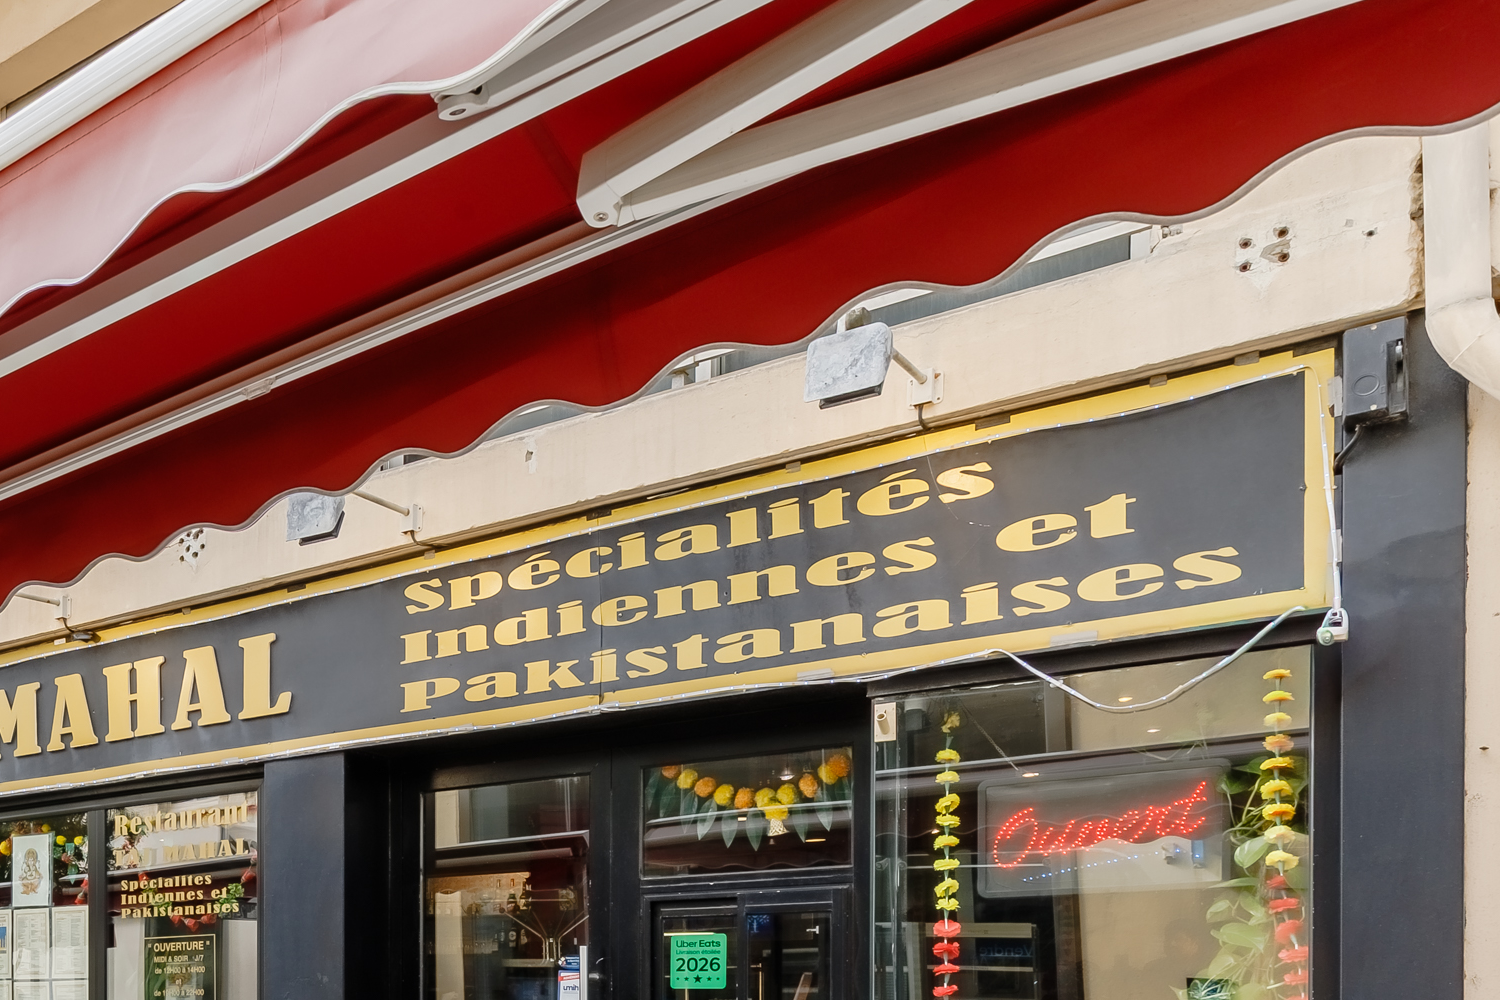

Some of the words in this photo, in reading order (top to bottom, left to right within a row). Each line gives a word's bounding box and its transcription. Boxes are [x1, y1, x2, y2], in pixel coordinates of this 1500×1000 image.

[400, 536, 937, 666] Indiennes
[995, 493, 1137, 553] et
[400, 546, 1242, 713] Pakistanaises
[113, 800, 248, 837] Restaurant
[993, 781, 1207, 868] Ouvert
[162, 838, 249, 863] MAHAL
[120, 889, 204, 905] Indiennes
[211, 886, 228, 899] et
[121, 902, 240, 919] Pakistanaises
[675, 940, 697, 948] Uber
[698, 939, 721, 948] Eats
[154, 967, 162, 975] de
[675, 957, 721, 972] 2026
